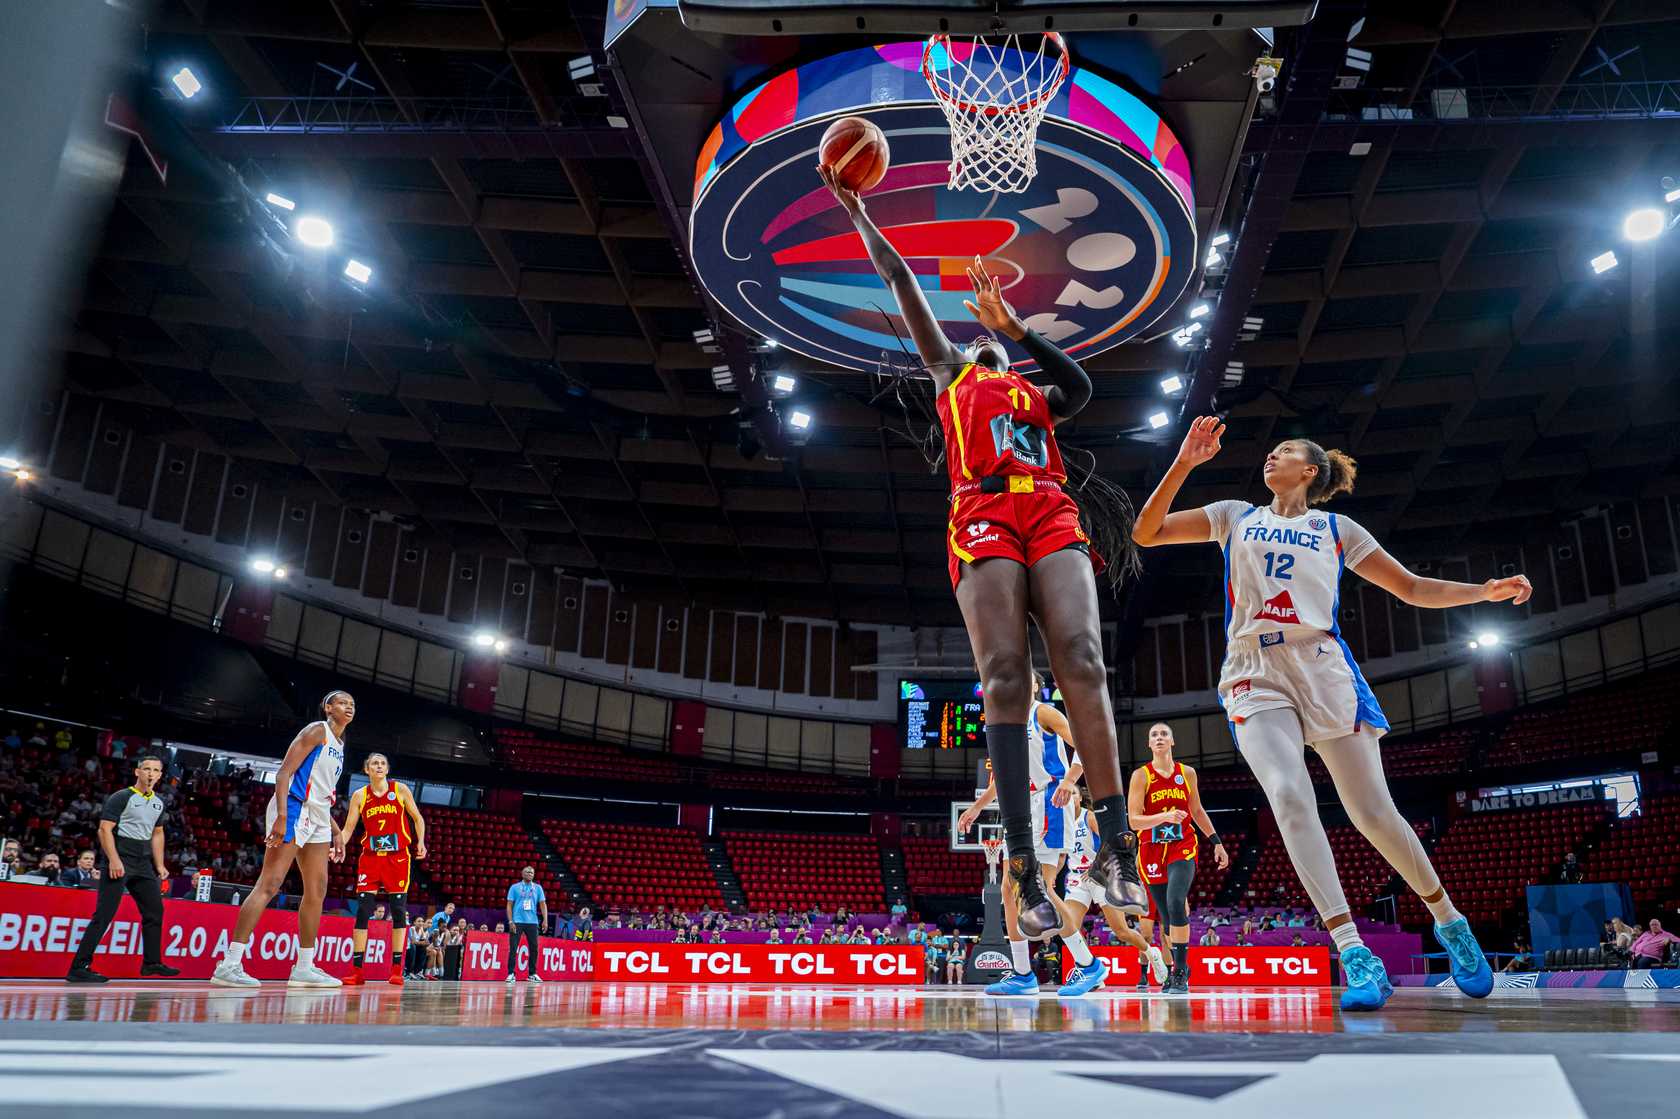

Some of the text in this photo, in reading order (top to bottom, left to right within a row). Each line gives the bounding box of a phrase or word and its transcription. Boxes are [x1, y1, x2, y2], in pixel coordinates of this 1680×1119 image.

[1008, 387, 1031, 411] 11
[1243, 527, 1322, 552] FRANCE
[1263, 551, 1296, 580] 12
[1262, 602, 1297, 618] MAIF
[964, 703, 981, 712] FRA
[1150, 787, 1187, 804] ESPAÑA
[1471, 796, 1510, 812] DARE
[1512, 792, 1536, 808] TO
[1538, 786, 1596, 805] DREAM
[366, 803, 398, 819] ESPAÑA
[377, 818, 387, 832] 7
[165, 925, 207, 958] 2.0
[212, 928, 254, 960] AR
[469, 942, 501, 970] TCL
[542, 947, 566, 972] TCL
[571, 949, 594, 972] TCL
[604, 951, 917, 975] TCL TCL TCL TCL
[1202, 957, 1318, 974] TCL TCL
